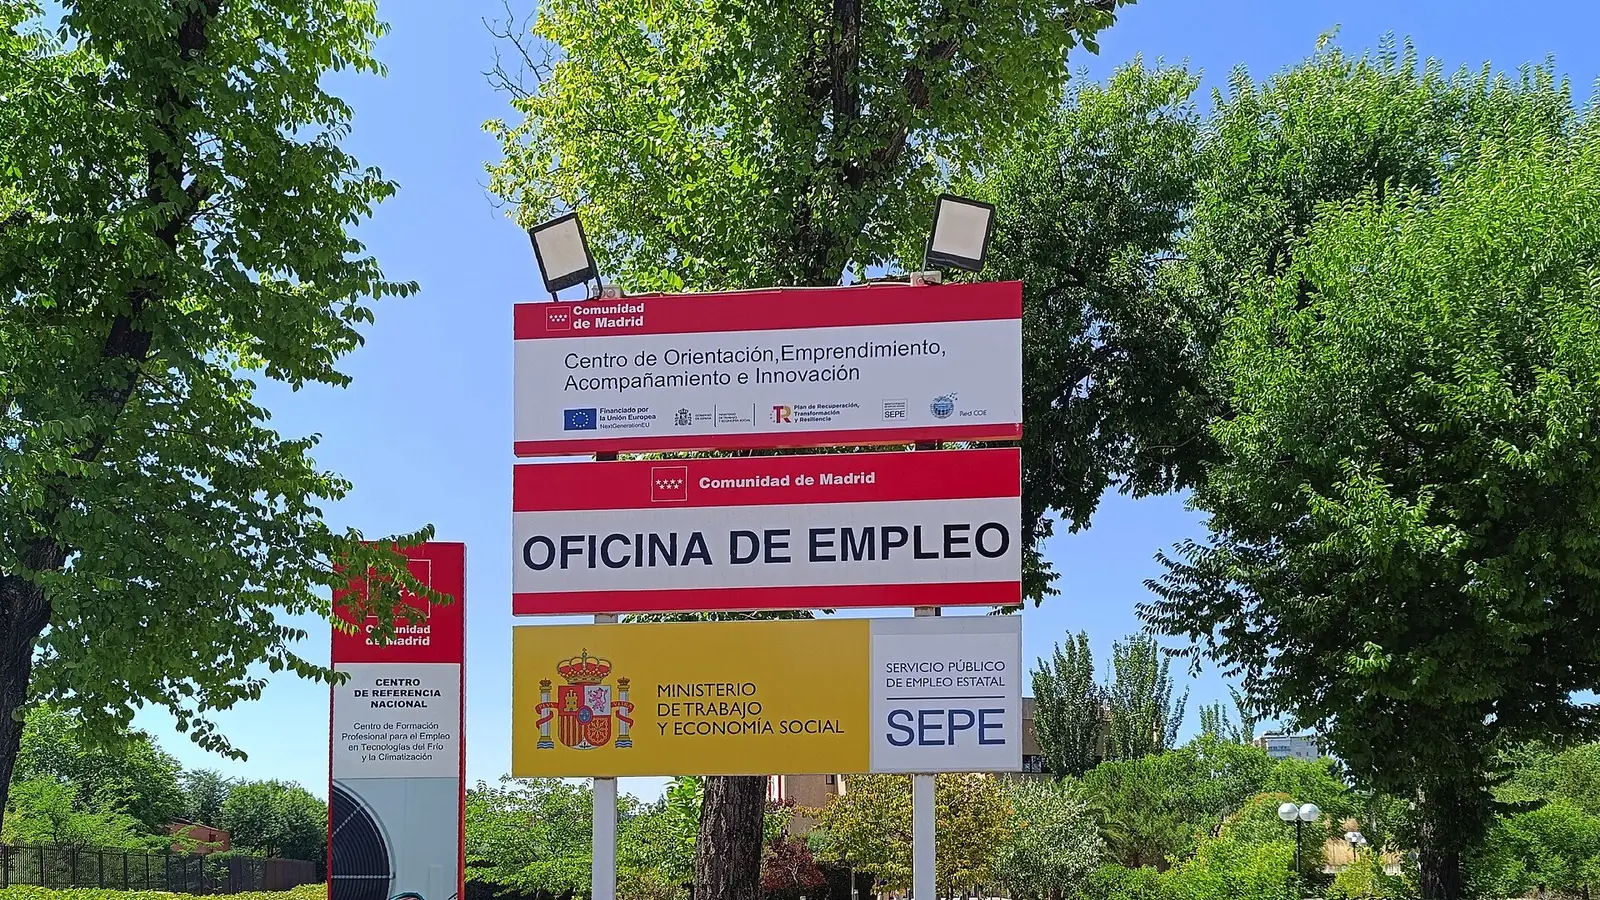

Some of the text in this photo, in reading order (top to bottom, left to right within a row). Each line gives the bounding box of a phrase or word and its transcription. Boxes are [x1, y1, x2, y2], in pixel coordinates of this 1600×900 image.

[573, 303, 644, 315] Comunidad
[573, 316, 644, 329] de Madrid
[564, 352, 628, 369] Centro
[634, 350, 658, 366] de
[564, 365, 860, 392] Acompañamiento e Innovación
[699, 472, 875, 489] Comunidad de Madrid
[523, 522, 1010, 570] OFICINA DE EMPLEO
[366, 624, 430, 634] Cunidad
[886, 659, 1005, 673] SERVICIO PÚBLICO
[376, 679, 420, 687] CENTRO
[886, 676, 1005, 688] DE EMPLEO ESTATAL
[658, 683, 756, 698] MINISTERIO
[658, 702, 762, 719] DE TRABAJO
[657, 718, 844, 736] Y ECONOMÍA SOCIAL
[886, 708, 1006, 746] SEPE
[420, 732, 450, 741] Empleo
[361, 743, 410, 752] Tecnologías
